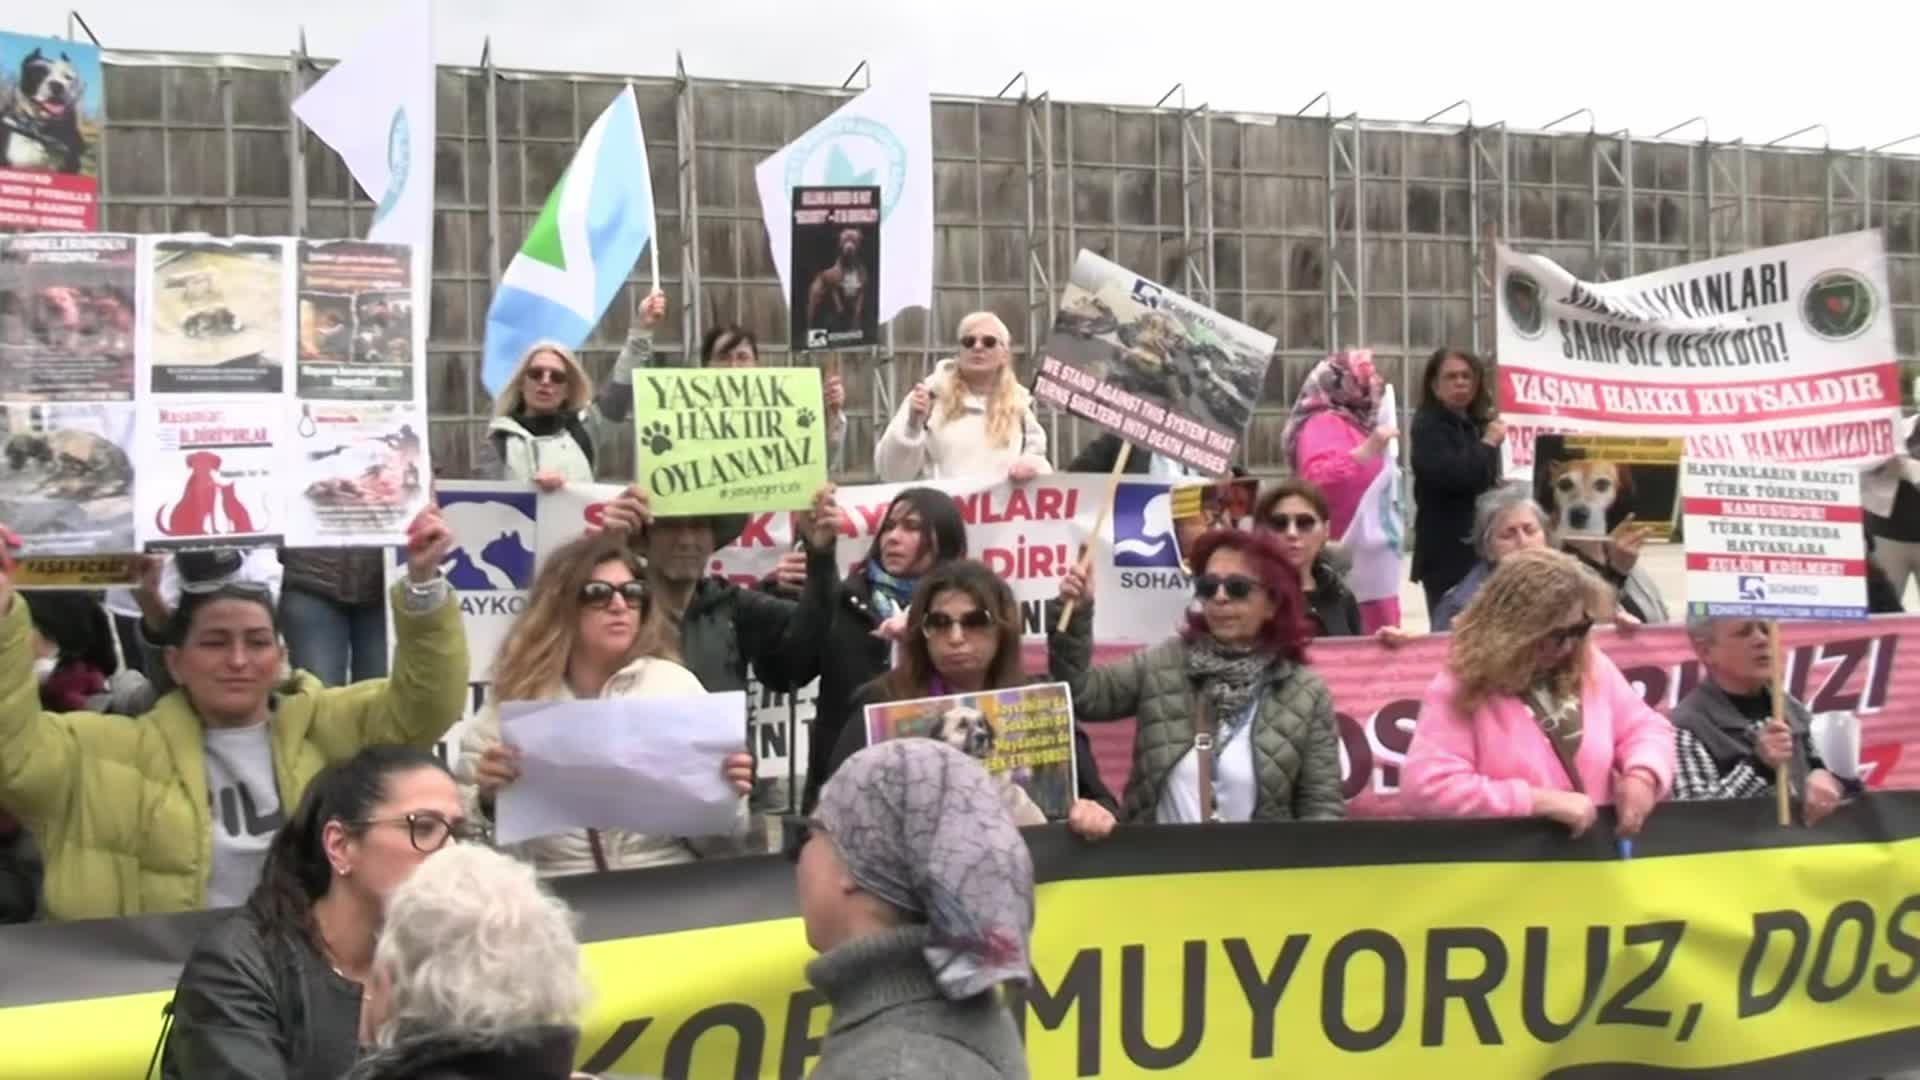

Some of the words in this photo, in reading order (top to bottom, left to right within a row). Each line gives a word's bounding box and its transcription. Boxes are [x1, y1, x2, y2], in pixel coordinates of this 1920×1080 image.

[1043, 357, 1062, 377] WE
[1060, 363, 1096, 392] STAND
[1095, 381, 1141, 413] AGAINST
[1140, 399, 1166, 425] THIS
[1165, 410, 1209, 442] SYSTEM
[1207, 427, 1236, 453] THAT
[1509, 373, 1600, 416] YAŞAM
[1601, 378, 1693, 416] HAKKI
[1694, 371, 1884, 416] KUTSALDIR
[676, 410, 786, 441] HAKTIR
[1036, 376, 1069, 405] TURNS
[1069, 393, 1123, 428] SHELTERS
[1122, 416, 1149, 441] INTO
[1148, 427, 1184, 456] DEATH
[1182, 441, 1228, 473] HOUSES
[651, 436, 817, 498] OYLANAMAZ
[1687, 463, 1797, 481] HAYVANLARIN
[1802, 469, 1855, 485] HAYATI
[1705, 481, 1750, 497] TÜRK
[1709, 520, 1755, 536] TÜRK
[1759, 523, 1841, 539] YURDUNDA
[1726, 540, 1827, 555] HAYVANLARA
